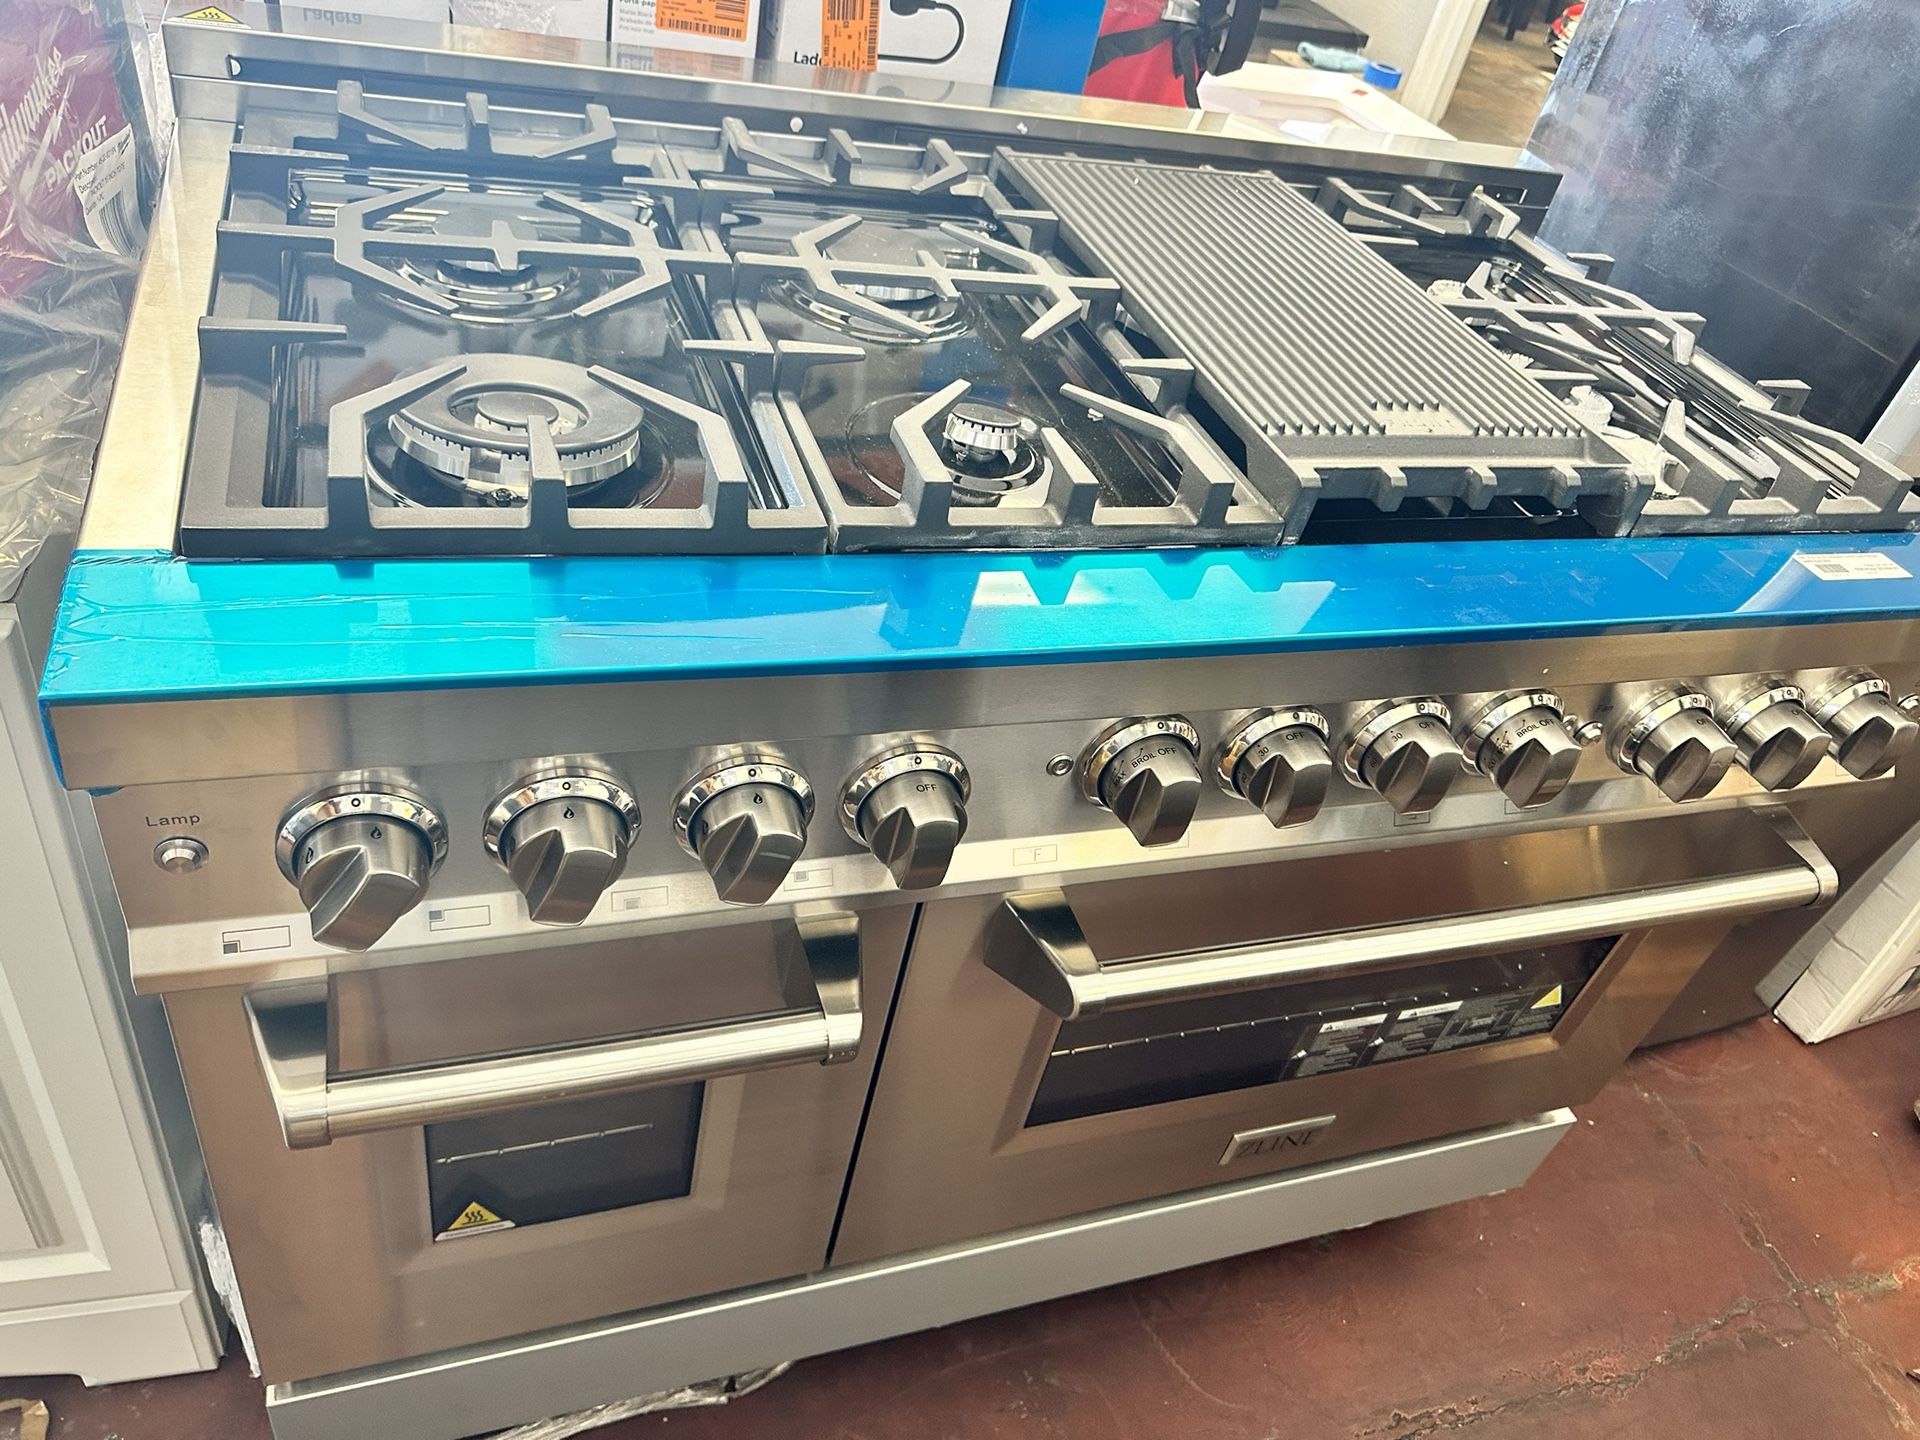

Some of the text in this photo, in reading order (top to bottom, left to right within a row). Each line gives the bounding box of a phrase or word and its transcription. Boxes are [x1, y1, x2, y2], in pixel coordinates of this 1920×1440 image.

[44, 114, 108, 192] PACKOUT
[1391, 731, 1404, 743] 30
[1418, 720, 1436, 729] OFF
[1516, 722, 1541, 738] BROIL
[1538, 718, 1555, 727] OFF
[1258, 746, 1270, 758] 30
[1285, 731, 1305, 741] OFF
[1131, 751, 1157, 769] BROIL
[1157, 746, 1178, 757] OFF
[915, 783, 938, 793] OFF
[145, 814, 201, 827] Lamp
